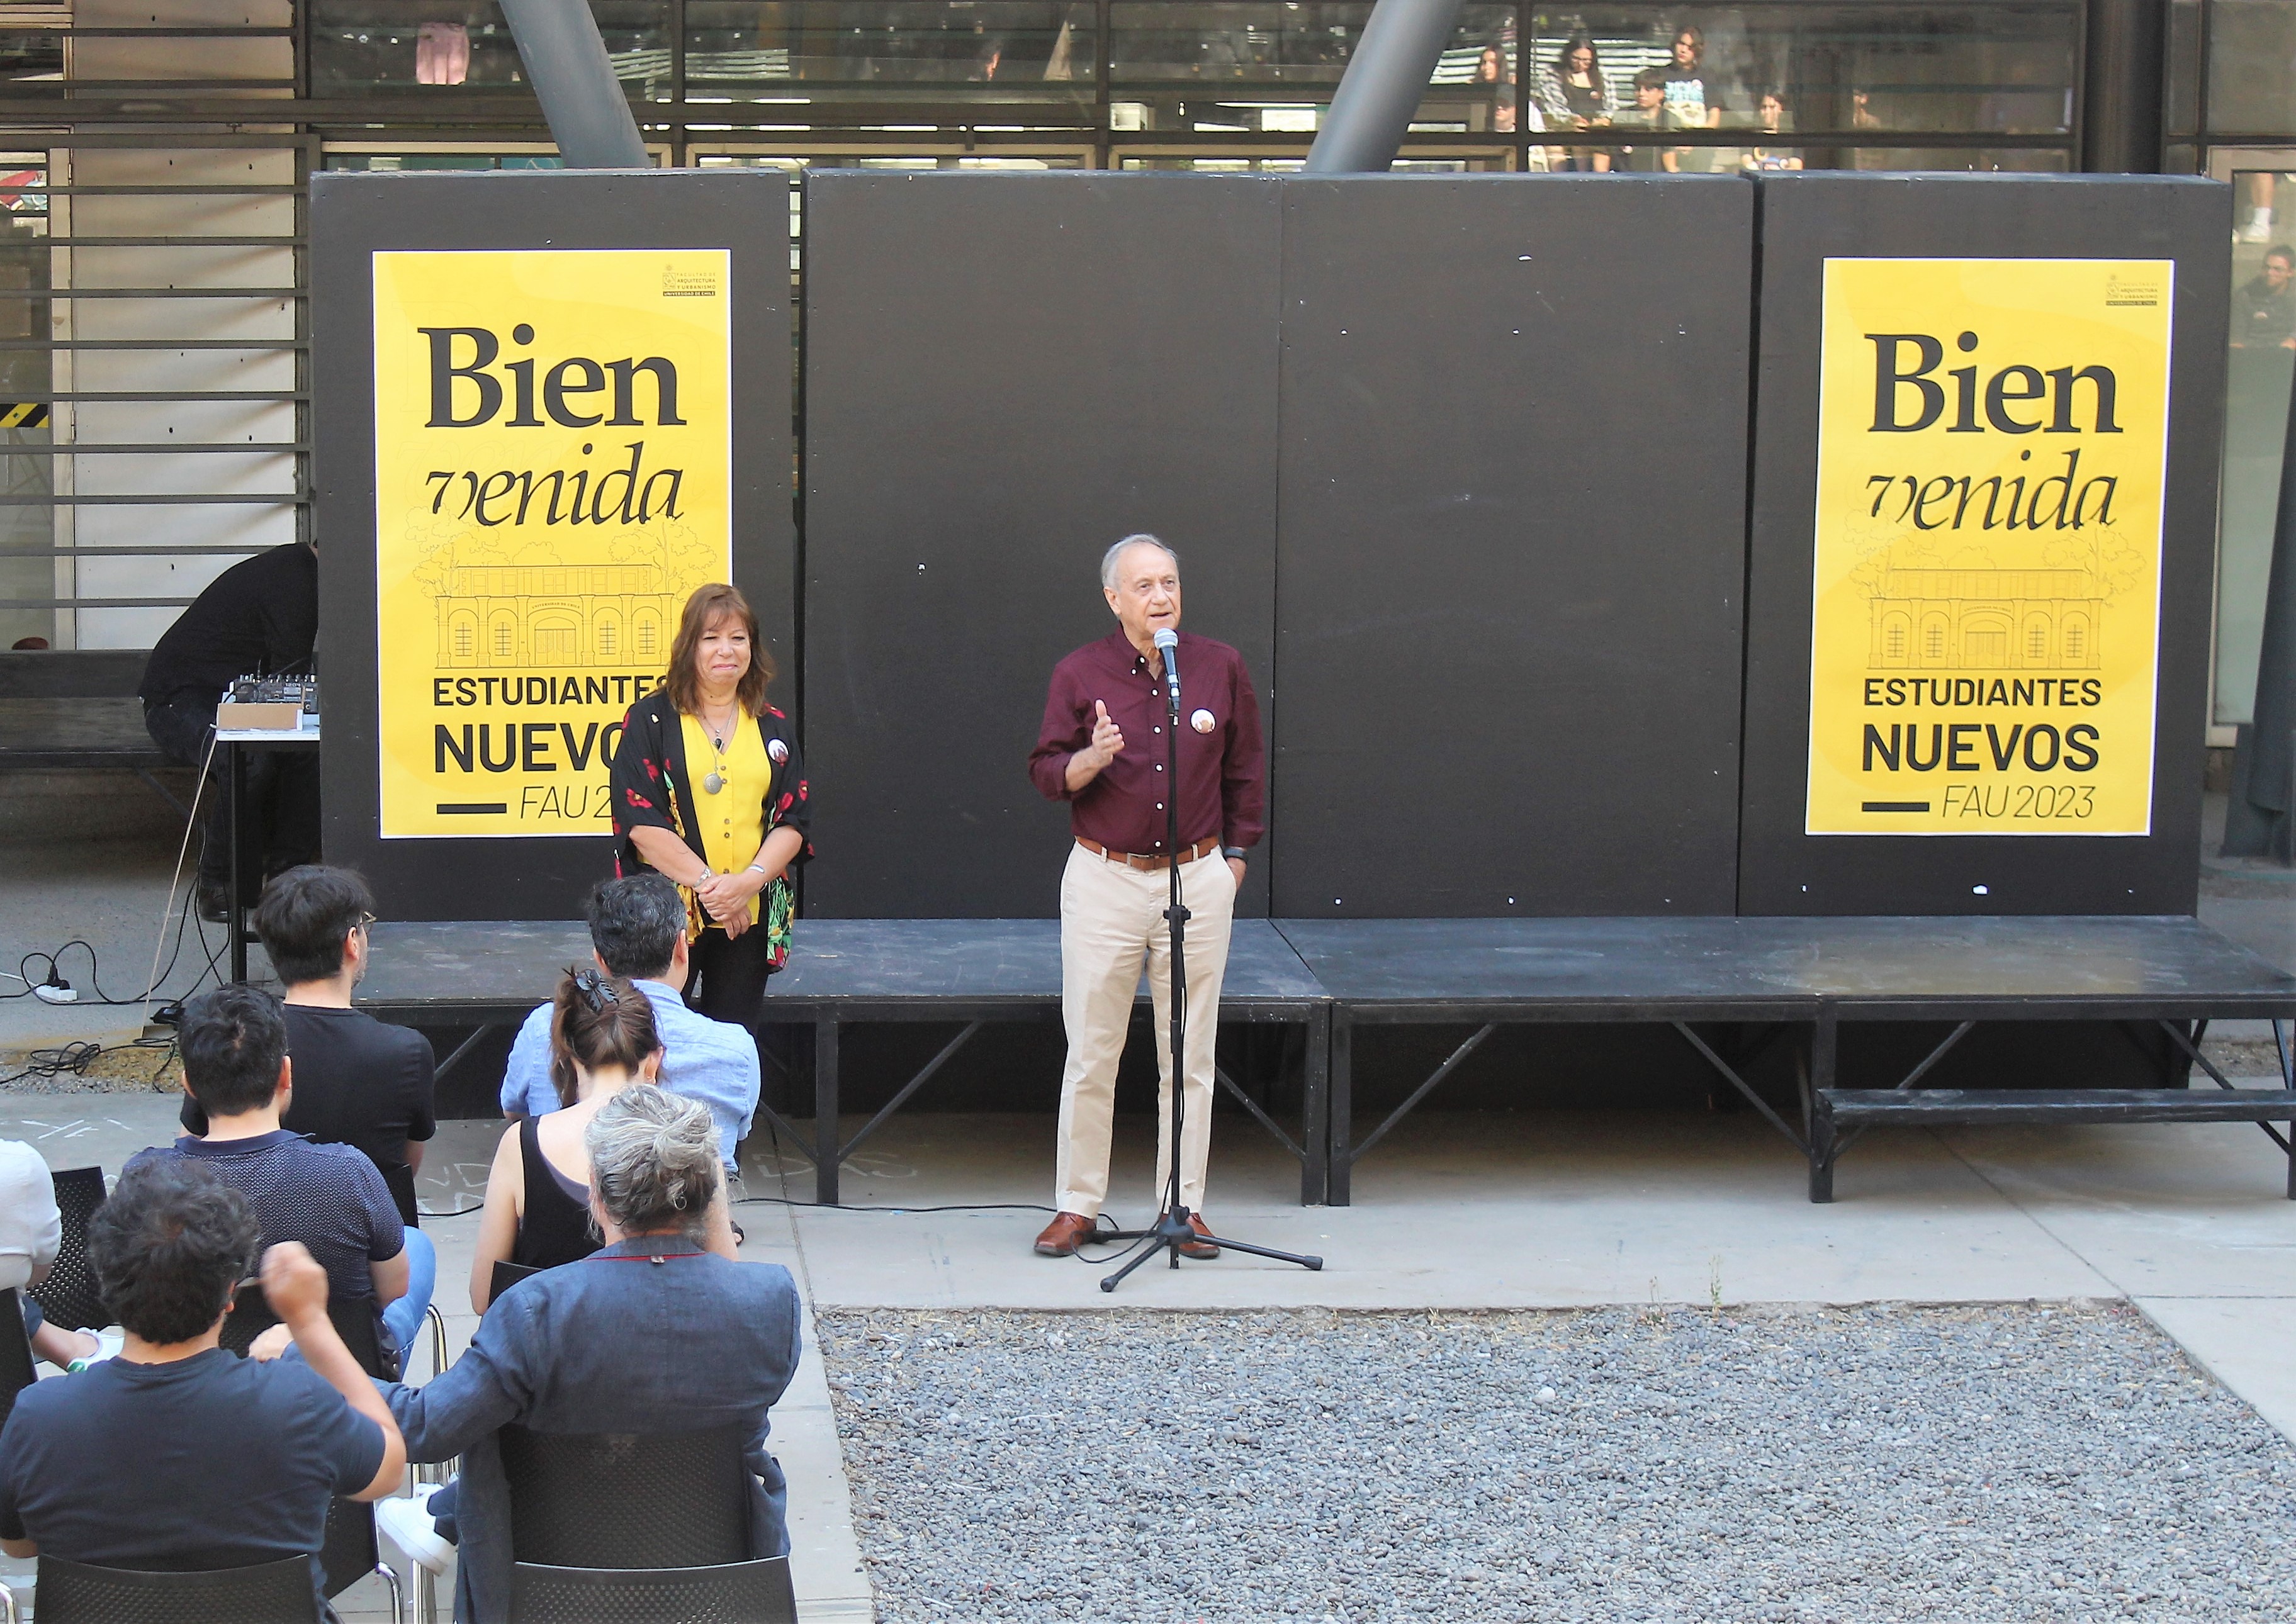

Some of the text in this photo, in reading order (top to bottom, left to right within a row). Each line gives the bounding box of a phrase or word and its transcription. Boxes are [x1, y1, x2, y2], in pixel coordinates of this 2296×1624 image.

[418, 323, 687, 428] Bien
[1864, 331, 2124, 434] Bien
[425, 440, 684, 526] venida
[1866, 448, 2119, 530] venida
[1864, 678, 2102, 707] ESTUDIANTES
[1862, 724, 2100, 772] NUEVOS
[521, 785, 588, 819] FAU
[1942, 785, 2096, 819] FAU 2023
